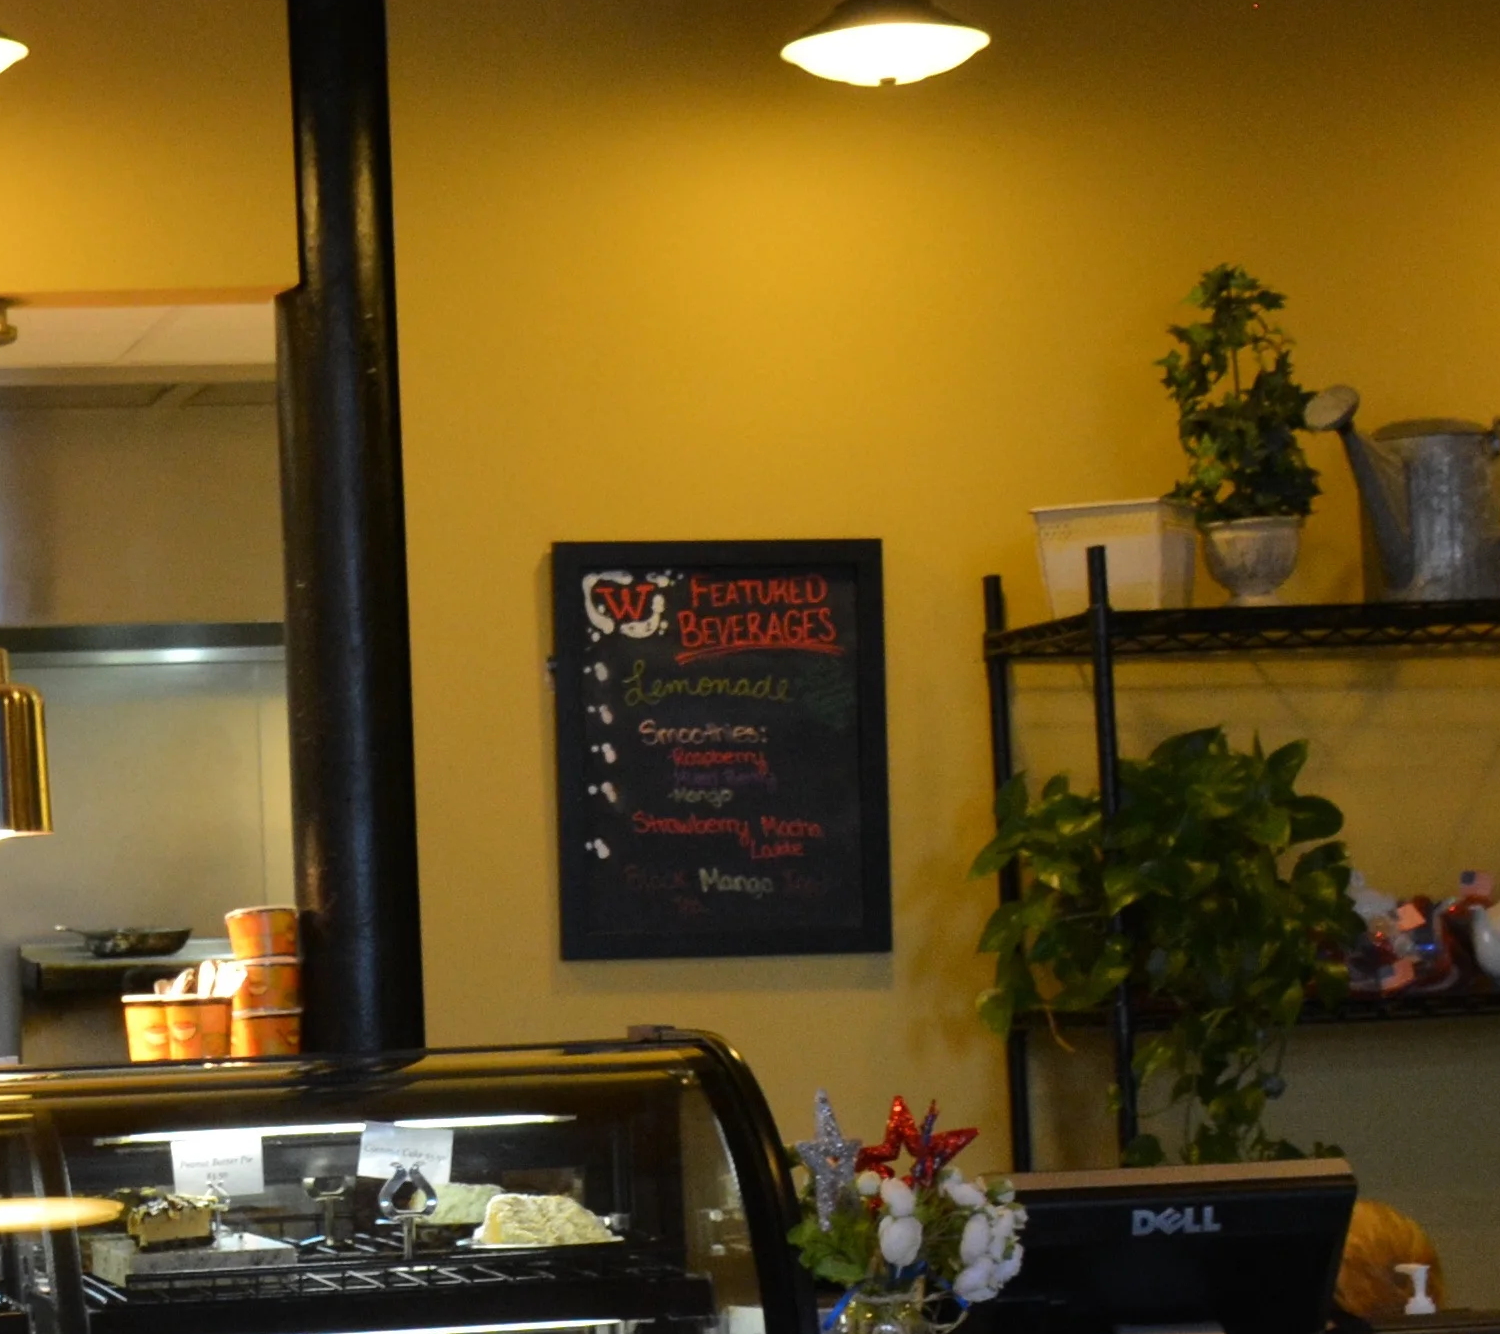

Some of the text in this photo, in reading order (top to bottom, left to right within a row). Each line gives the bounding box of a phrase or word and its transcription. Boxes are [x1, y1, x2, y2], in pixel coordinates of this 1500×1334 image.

[593, 582, 656, 621] W
[689, 573, 829, 607] FEATURED
[677, 608, 838, 648] BEVERAGES
[622, 659, 794, 706] Lemonade
[630, 809, 752, 849] Strawberry
[698, 866, 775, 899] Mango
[1131, 1205, 1222, 1237] DELL
